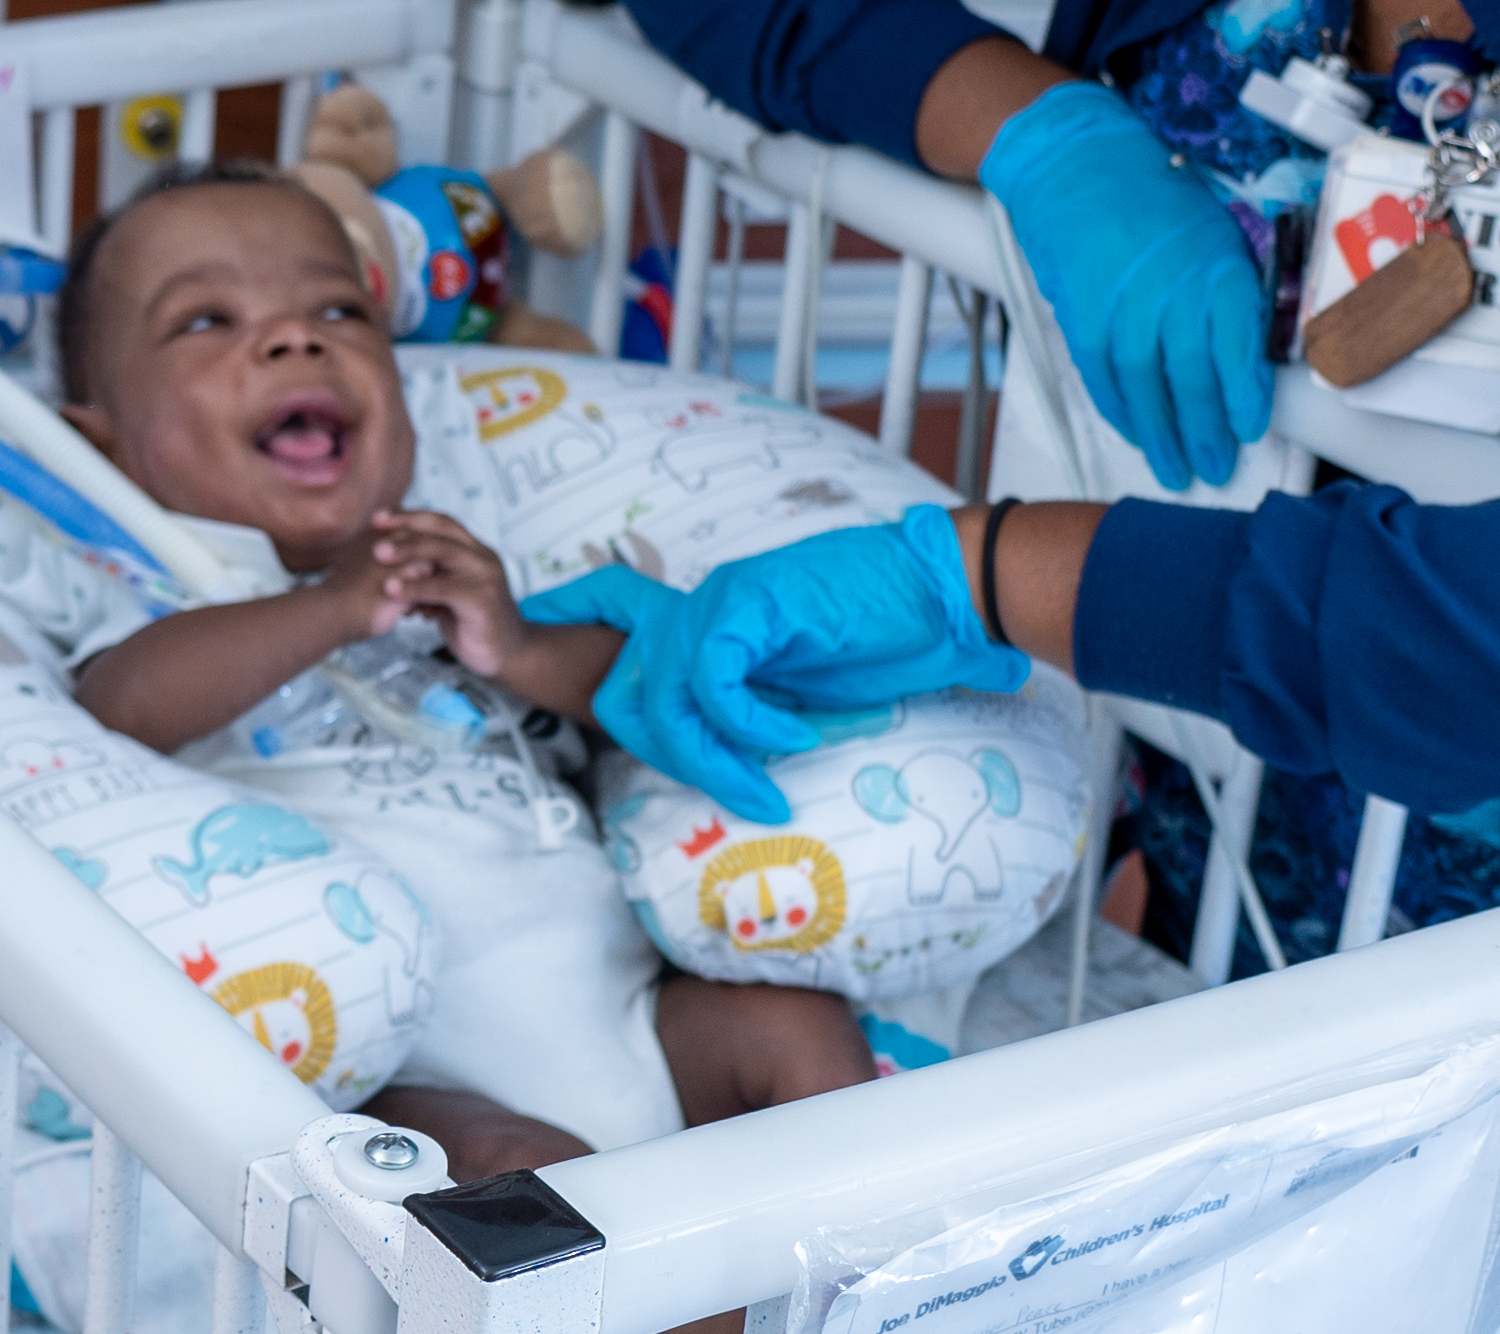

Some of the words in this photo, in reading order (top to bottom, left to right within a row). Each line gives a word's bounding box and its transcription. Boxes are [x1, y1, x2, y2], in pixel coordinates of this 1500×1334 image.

[914, 1273, 1008, 1321] DiMaggio
[1050, 1223, 1146, 1267] Children's
[1148, 1193, 1232, 1234] Hospital
[1111, 1269, 1148, 1295] have
